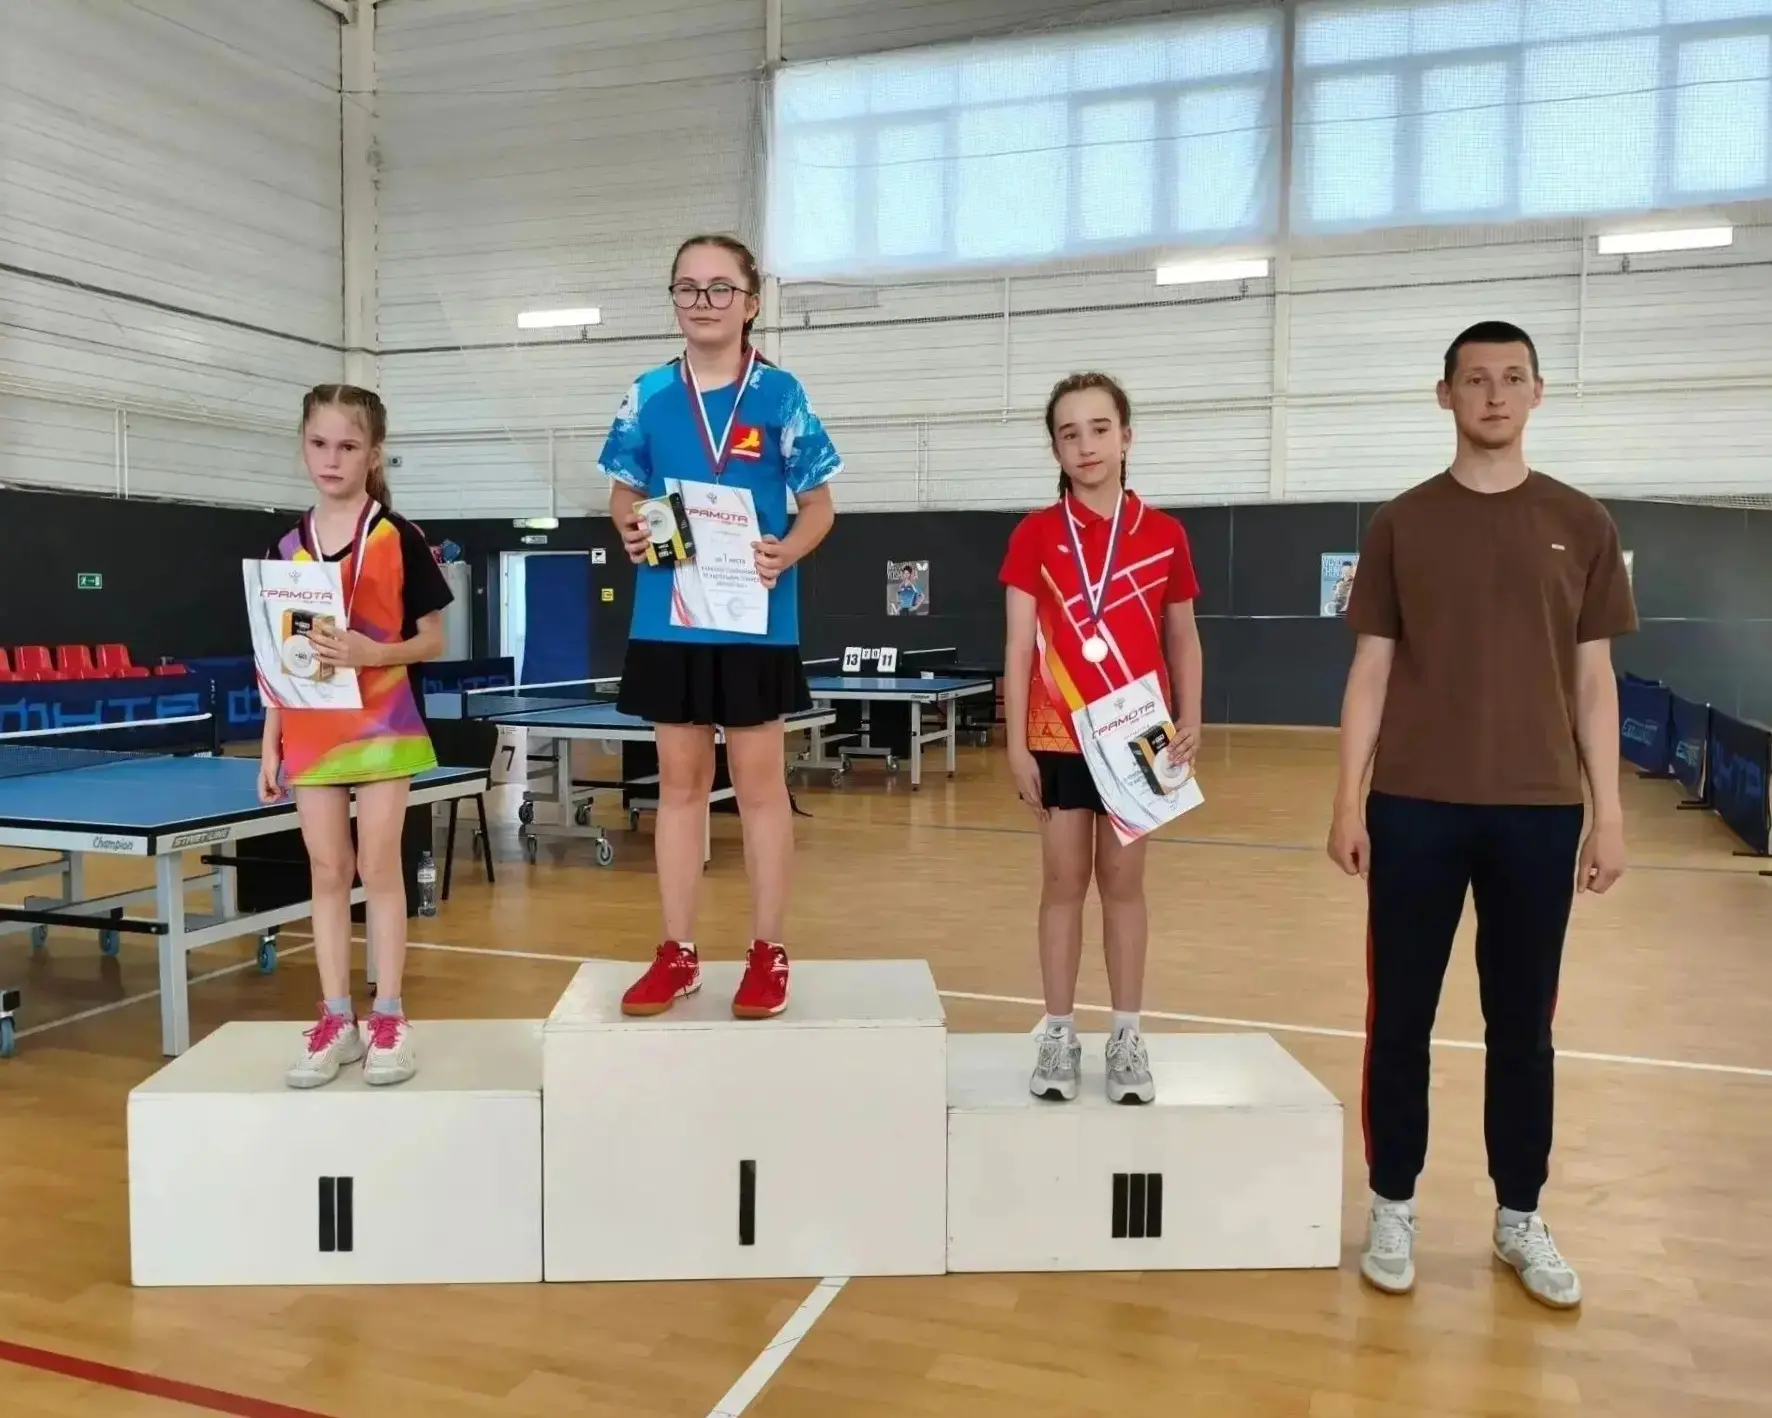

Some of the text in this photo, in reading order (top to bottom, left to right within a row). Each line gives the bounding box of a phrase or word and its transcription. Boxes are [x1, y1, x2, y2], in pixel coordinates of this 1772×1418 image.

[260, 589, 333, 600] ГРАМОТА
[846, 653, 858, 665] 13
[882, 654, 893, 666] 11
[1092, 701, 1155, 739] ГРАМОТА
[501, 745, 515, 771] 7
[92, 836, 134, 851] Champion
[318, 1176, 353, 1252] II
[1112, 1173, 1162, 1238] III
